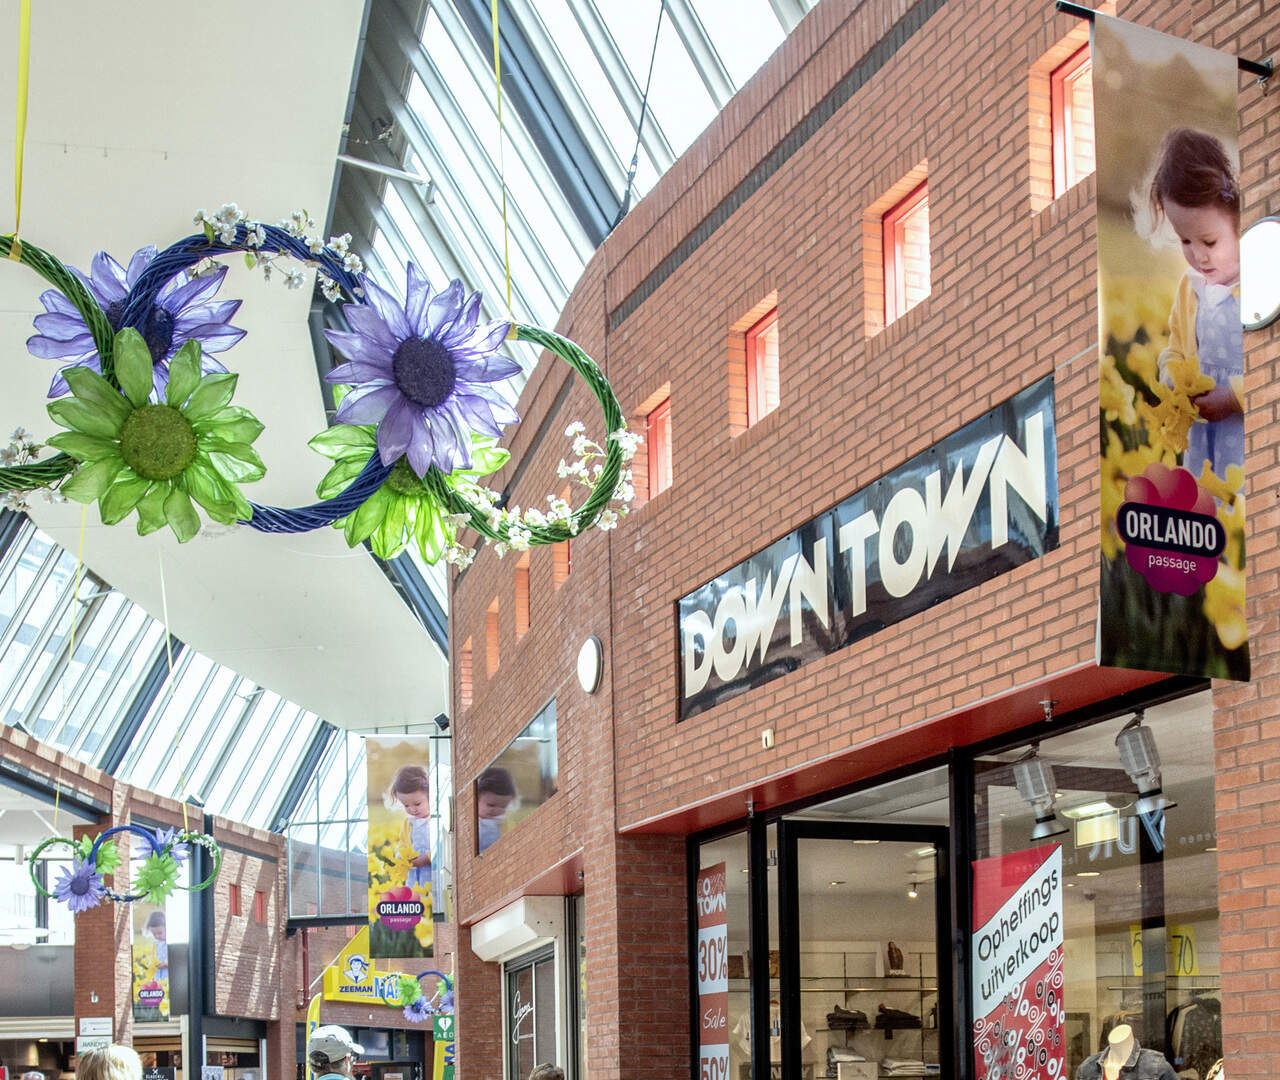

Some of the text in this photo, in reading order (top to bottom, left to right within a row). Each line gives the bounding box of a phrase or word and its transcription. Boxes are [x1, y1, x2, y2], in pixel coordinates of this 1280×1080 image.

[1126, 510, 1218, 552] ORLANDO
[683, 411, 1047, 699] DOWN TOWN
[1148, 553, 1198, 574] passage
[380, 903, 421, 914] ORLANDO
[697, 892, 727, 917] TOWN
[978, 868, 1059, 962] Opheffings
[698, 935, 727, 983] 30%
[981, 911, 1060, 1001] uitverkoop
[1172, 934, 1195, 975] 70
[339, 985, 373, 993] ZEEMAN
[703, 1008, 727, 1030] Sale
